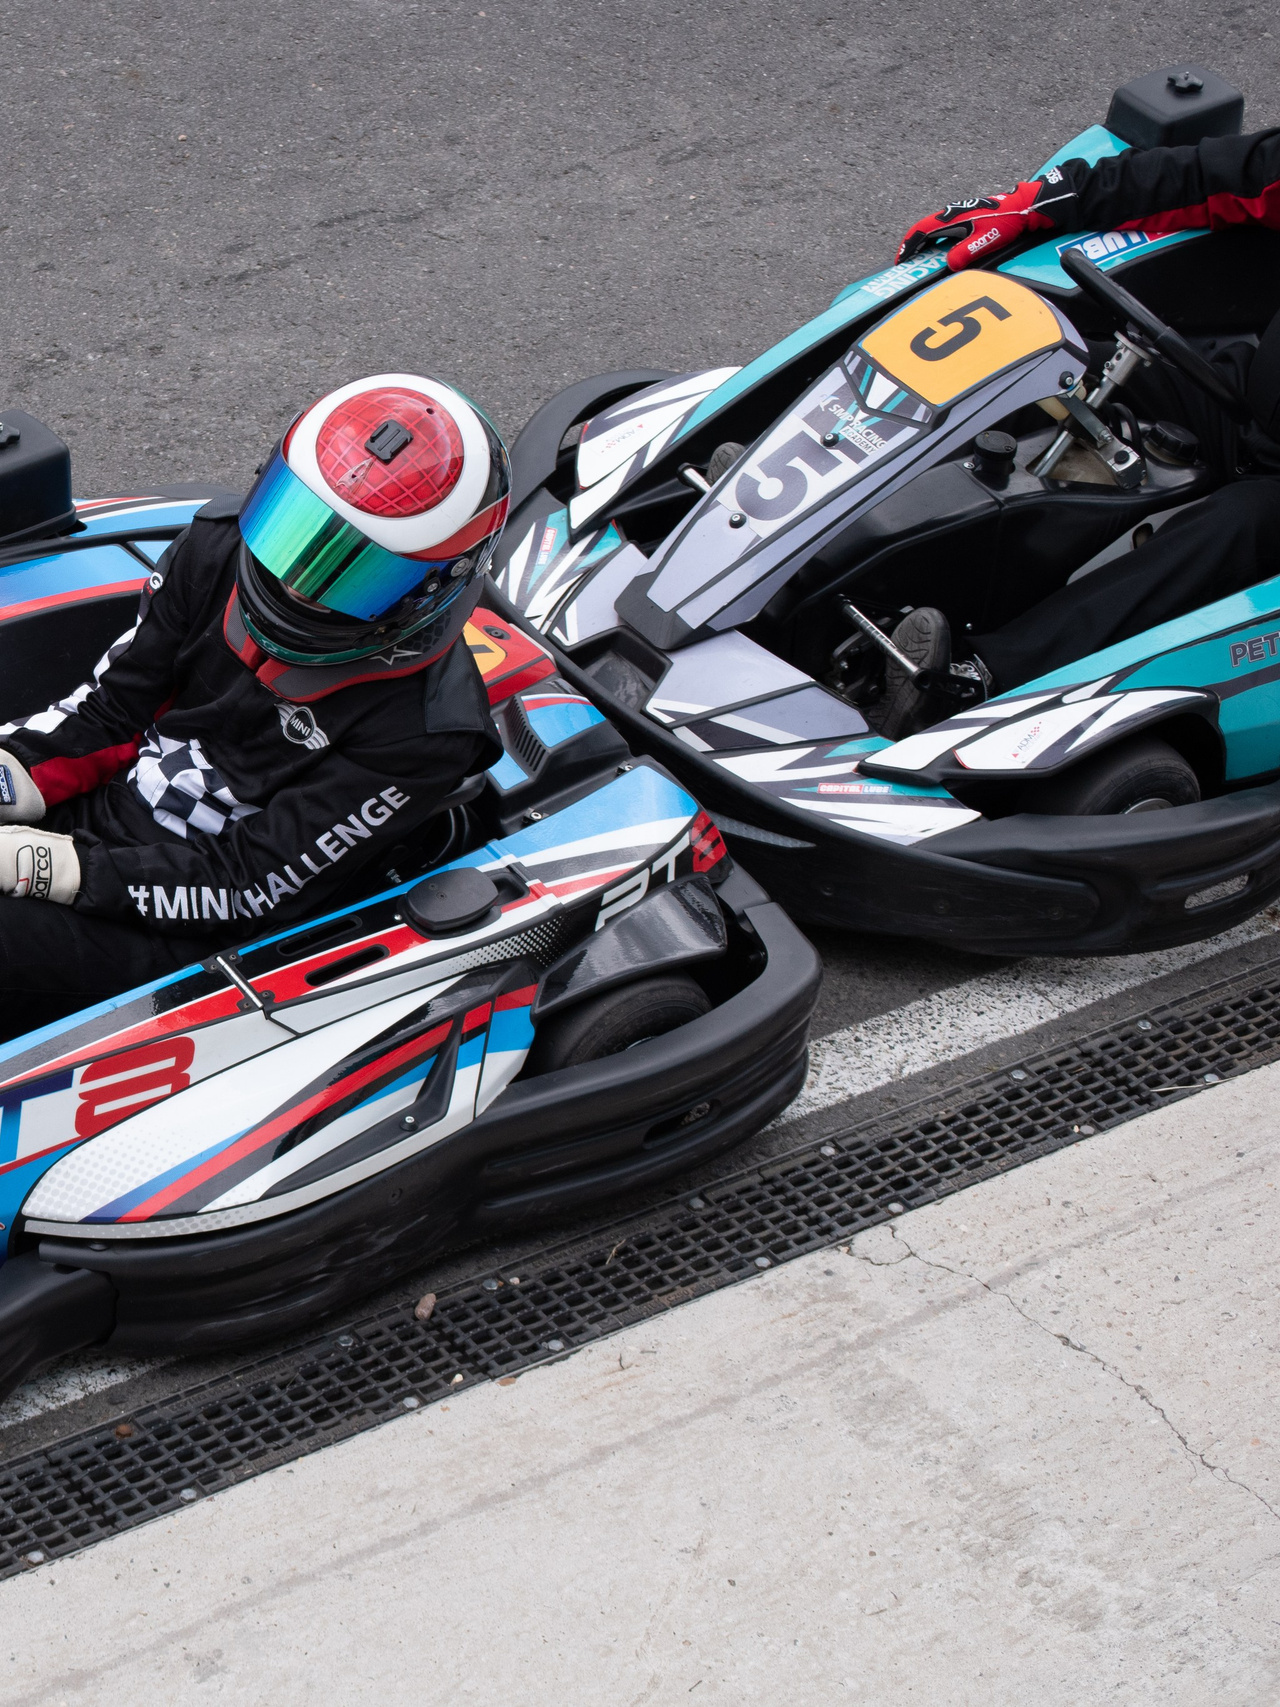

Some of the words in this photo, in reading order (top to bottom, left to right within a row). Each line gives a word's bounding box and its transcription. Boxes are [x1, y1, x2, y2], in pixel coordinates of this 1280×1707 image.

[967, 228, 1001, 254] sparco
[909, 295, 1013, 362] 5
[828, 404, 855, 421] SMP
[848, 420, 887, 448] RACING
[842, 428, 877, 454] ACADEMY
[735, 430, 843, 521] 5
[1229, 630, 1280, 667] PET
[289, 715, 311, 737] MINI
[820, 784, 861, 793] CAPITAL
[863, 785, 889, 793] LUBE
[33, 846, 48, 898] parco
